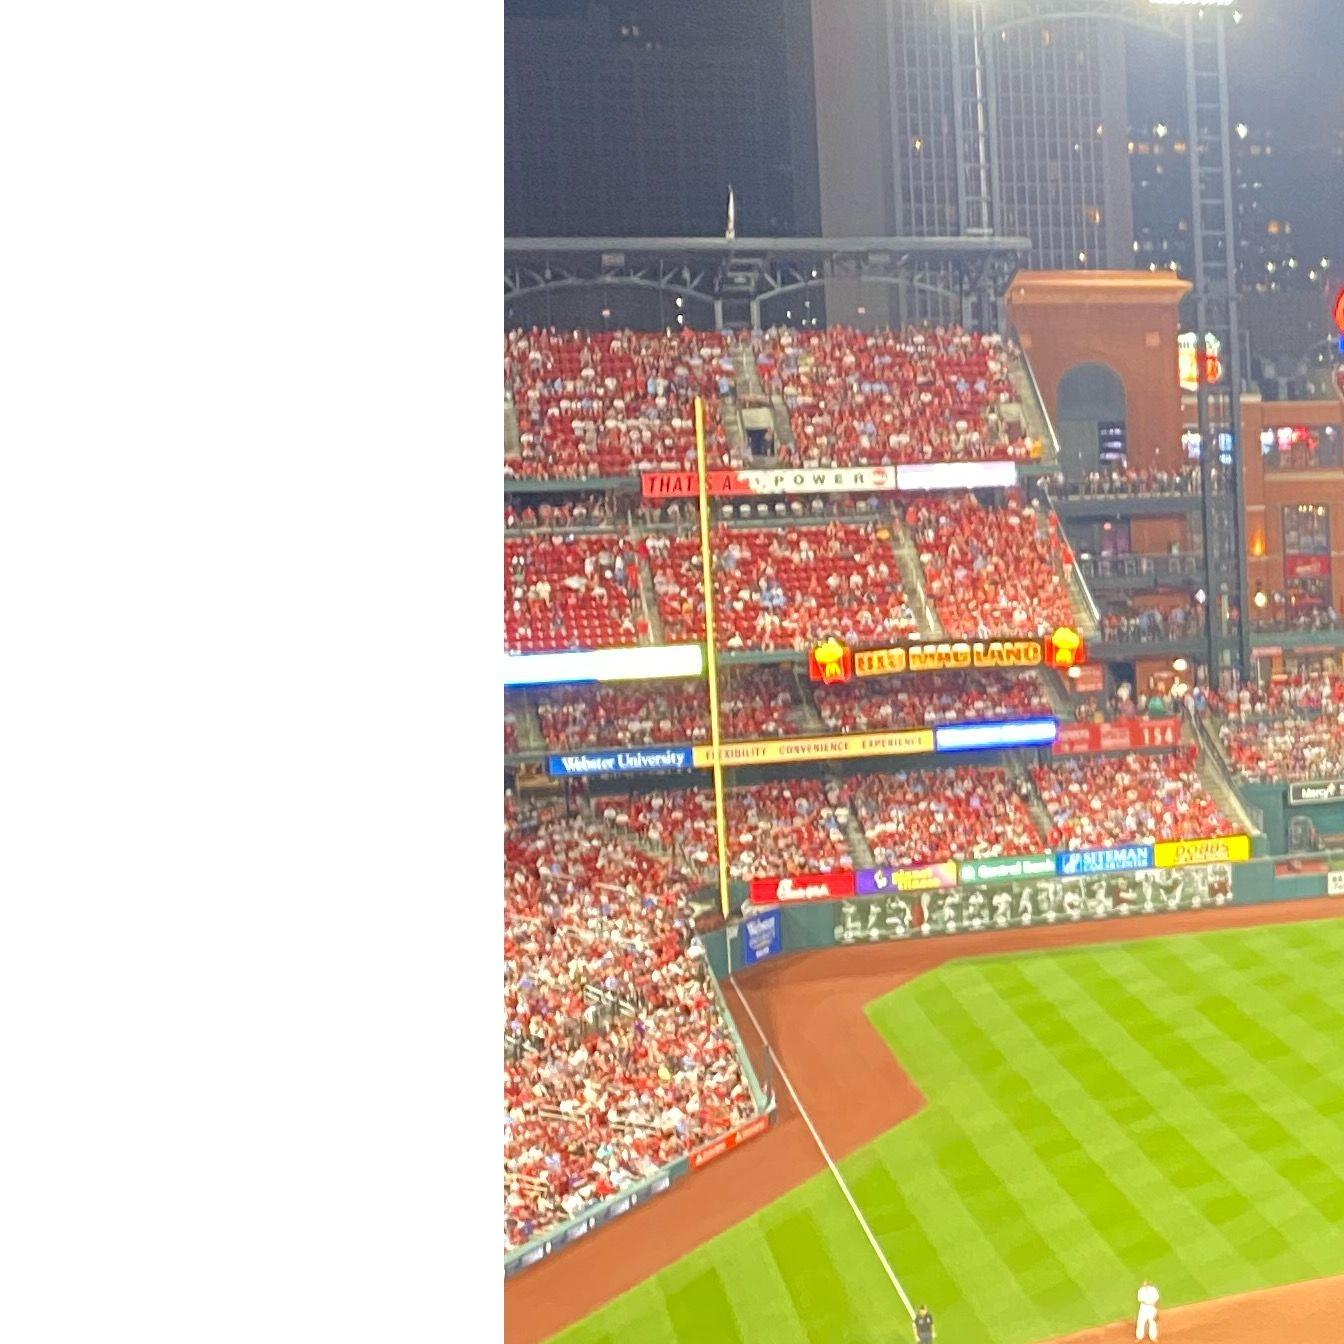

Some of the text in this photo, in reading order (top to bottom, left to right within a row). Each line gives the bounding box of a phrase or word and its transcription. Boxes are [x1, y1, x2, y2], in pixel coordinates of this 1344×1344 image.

[722, 477, 732, 491] A
[774, 474, 865, 488] POWER
[973, 641, 1041, 667] LAND
[1143, 727, 1173, 745] 154
[778, 741, 849, 756] CONVENIENCE
[861, 736, 923, 750] EXPERIENCE
[562, 749, 684, 773] Webster University
[1301, 786, 1329, 800] Mercy
[1082, 848, 1149, 865] SITEMAN
